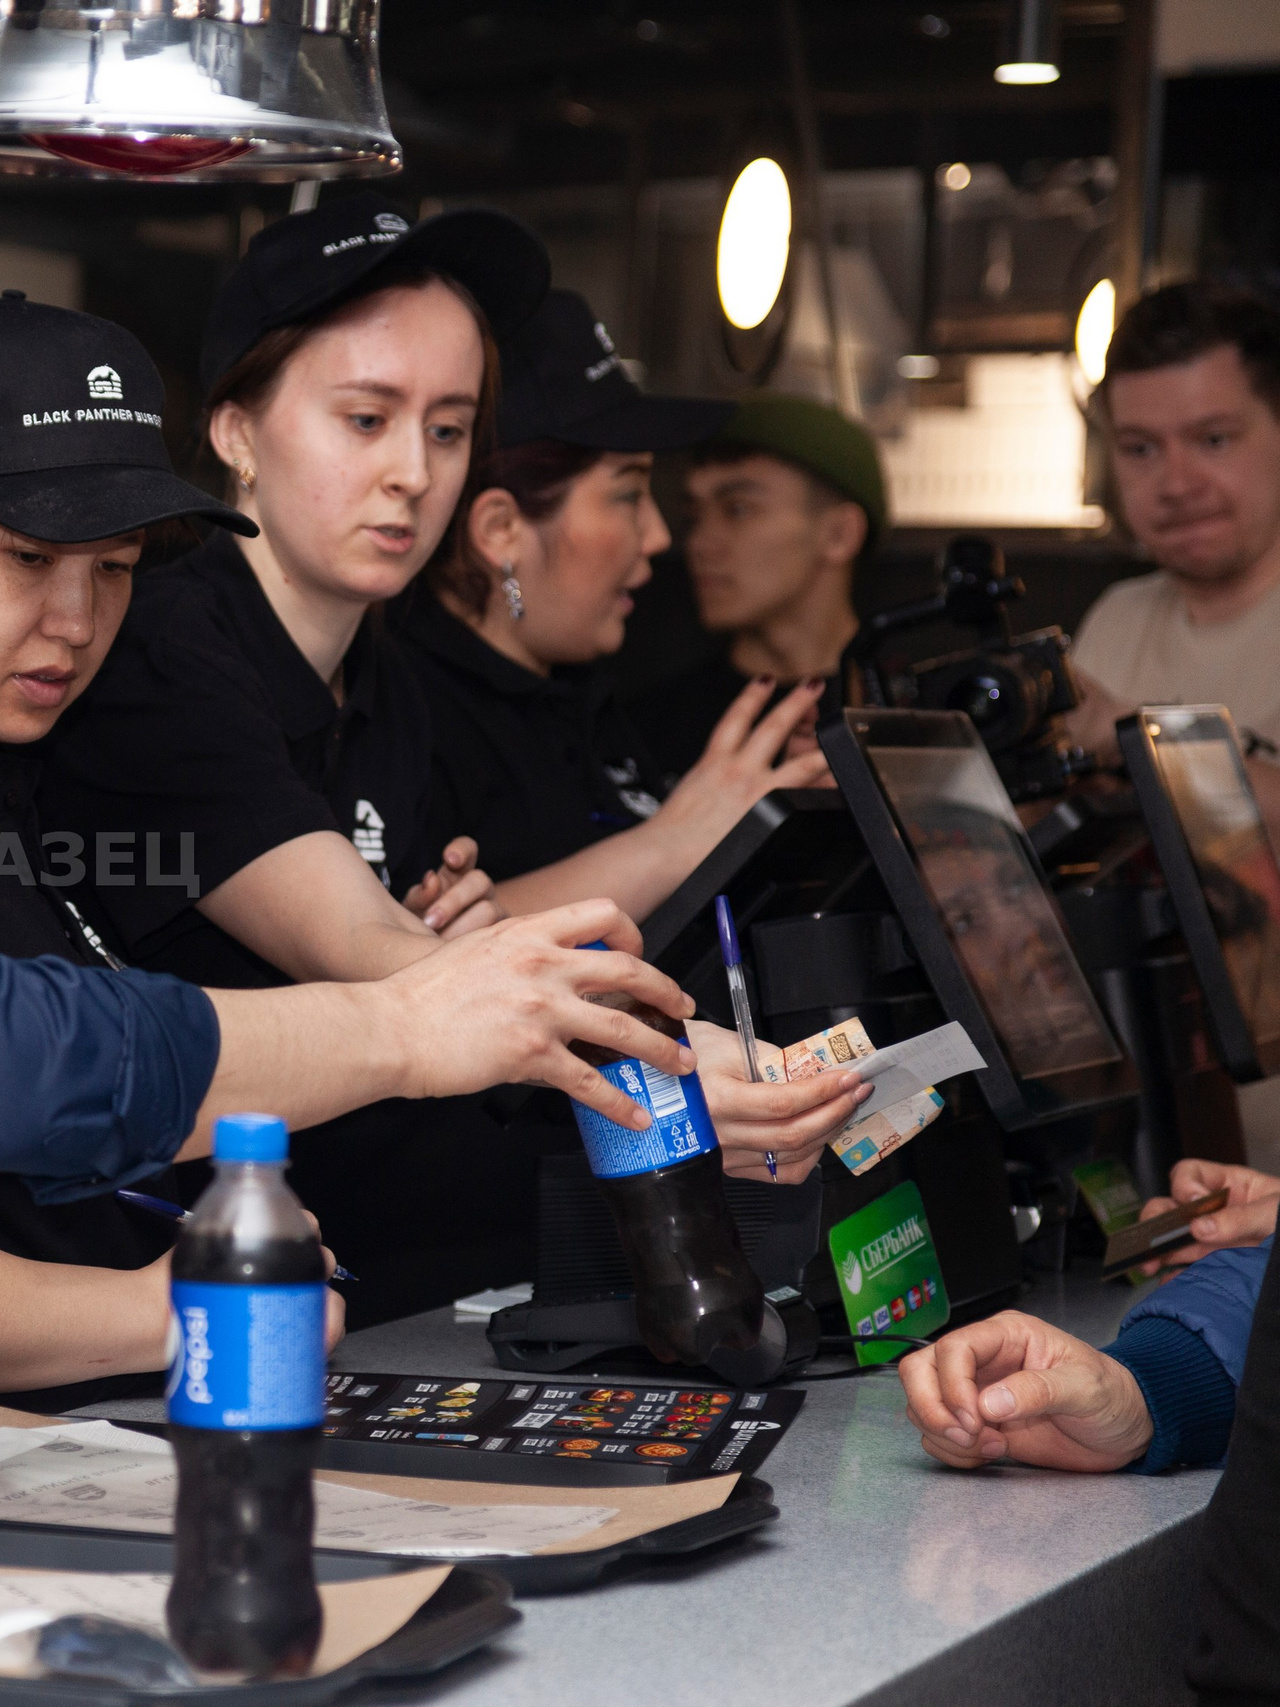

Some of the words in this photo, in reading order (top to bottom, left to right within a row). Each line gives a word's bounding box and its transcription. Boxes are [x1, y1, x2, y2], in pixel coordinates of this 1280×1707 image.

[22, 410, 71, 427] BLACK
[75, 408, 133, 422] PANTHER
[860, 1214, 924, 1272] СБЕРБАНК
